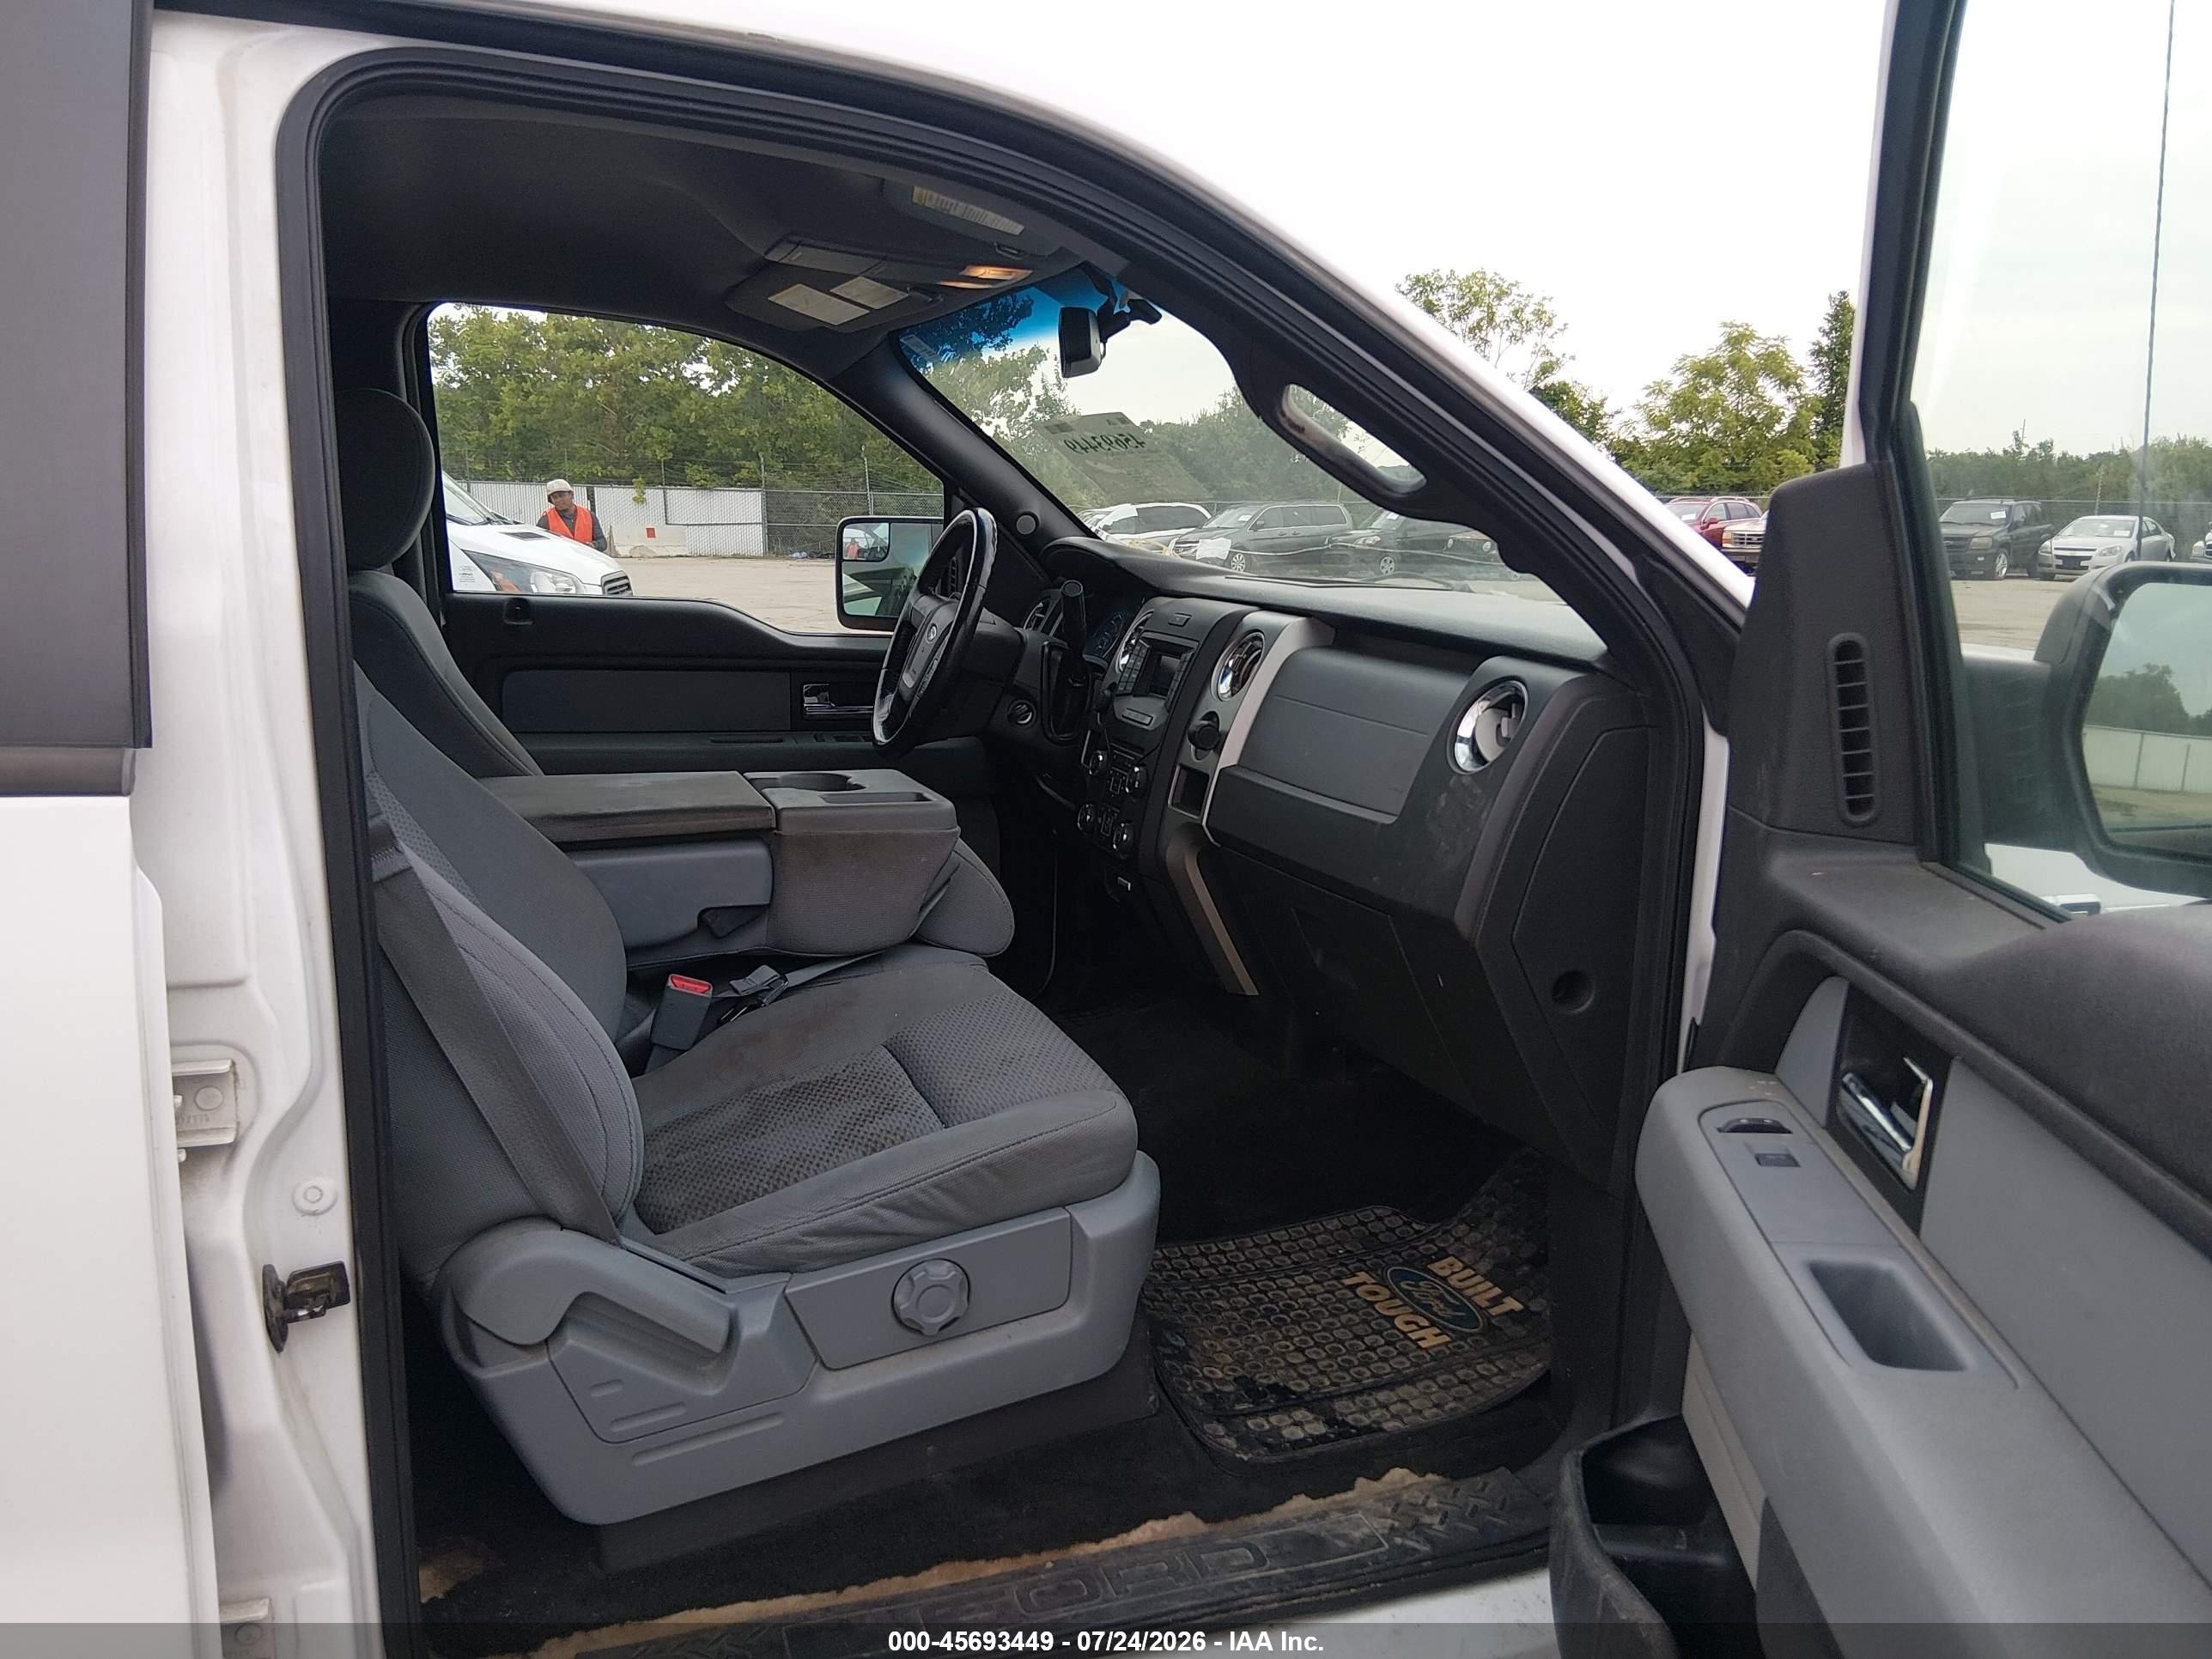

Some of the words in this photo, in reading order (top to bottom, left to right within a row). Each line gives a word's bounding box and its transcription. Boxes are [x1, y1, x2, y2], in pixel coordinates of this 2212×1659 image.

[1340, 1271, 1452, 1350] TOUGH
[1400, 1279, 1467, 1319] Ford
[1427, 1255, 1525, 1316] BUILT
